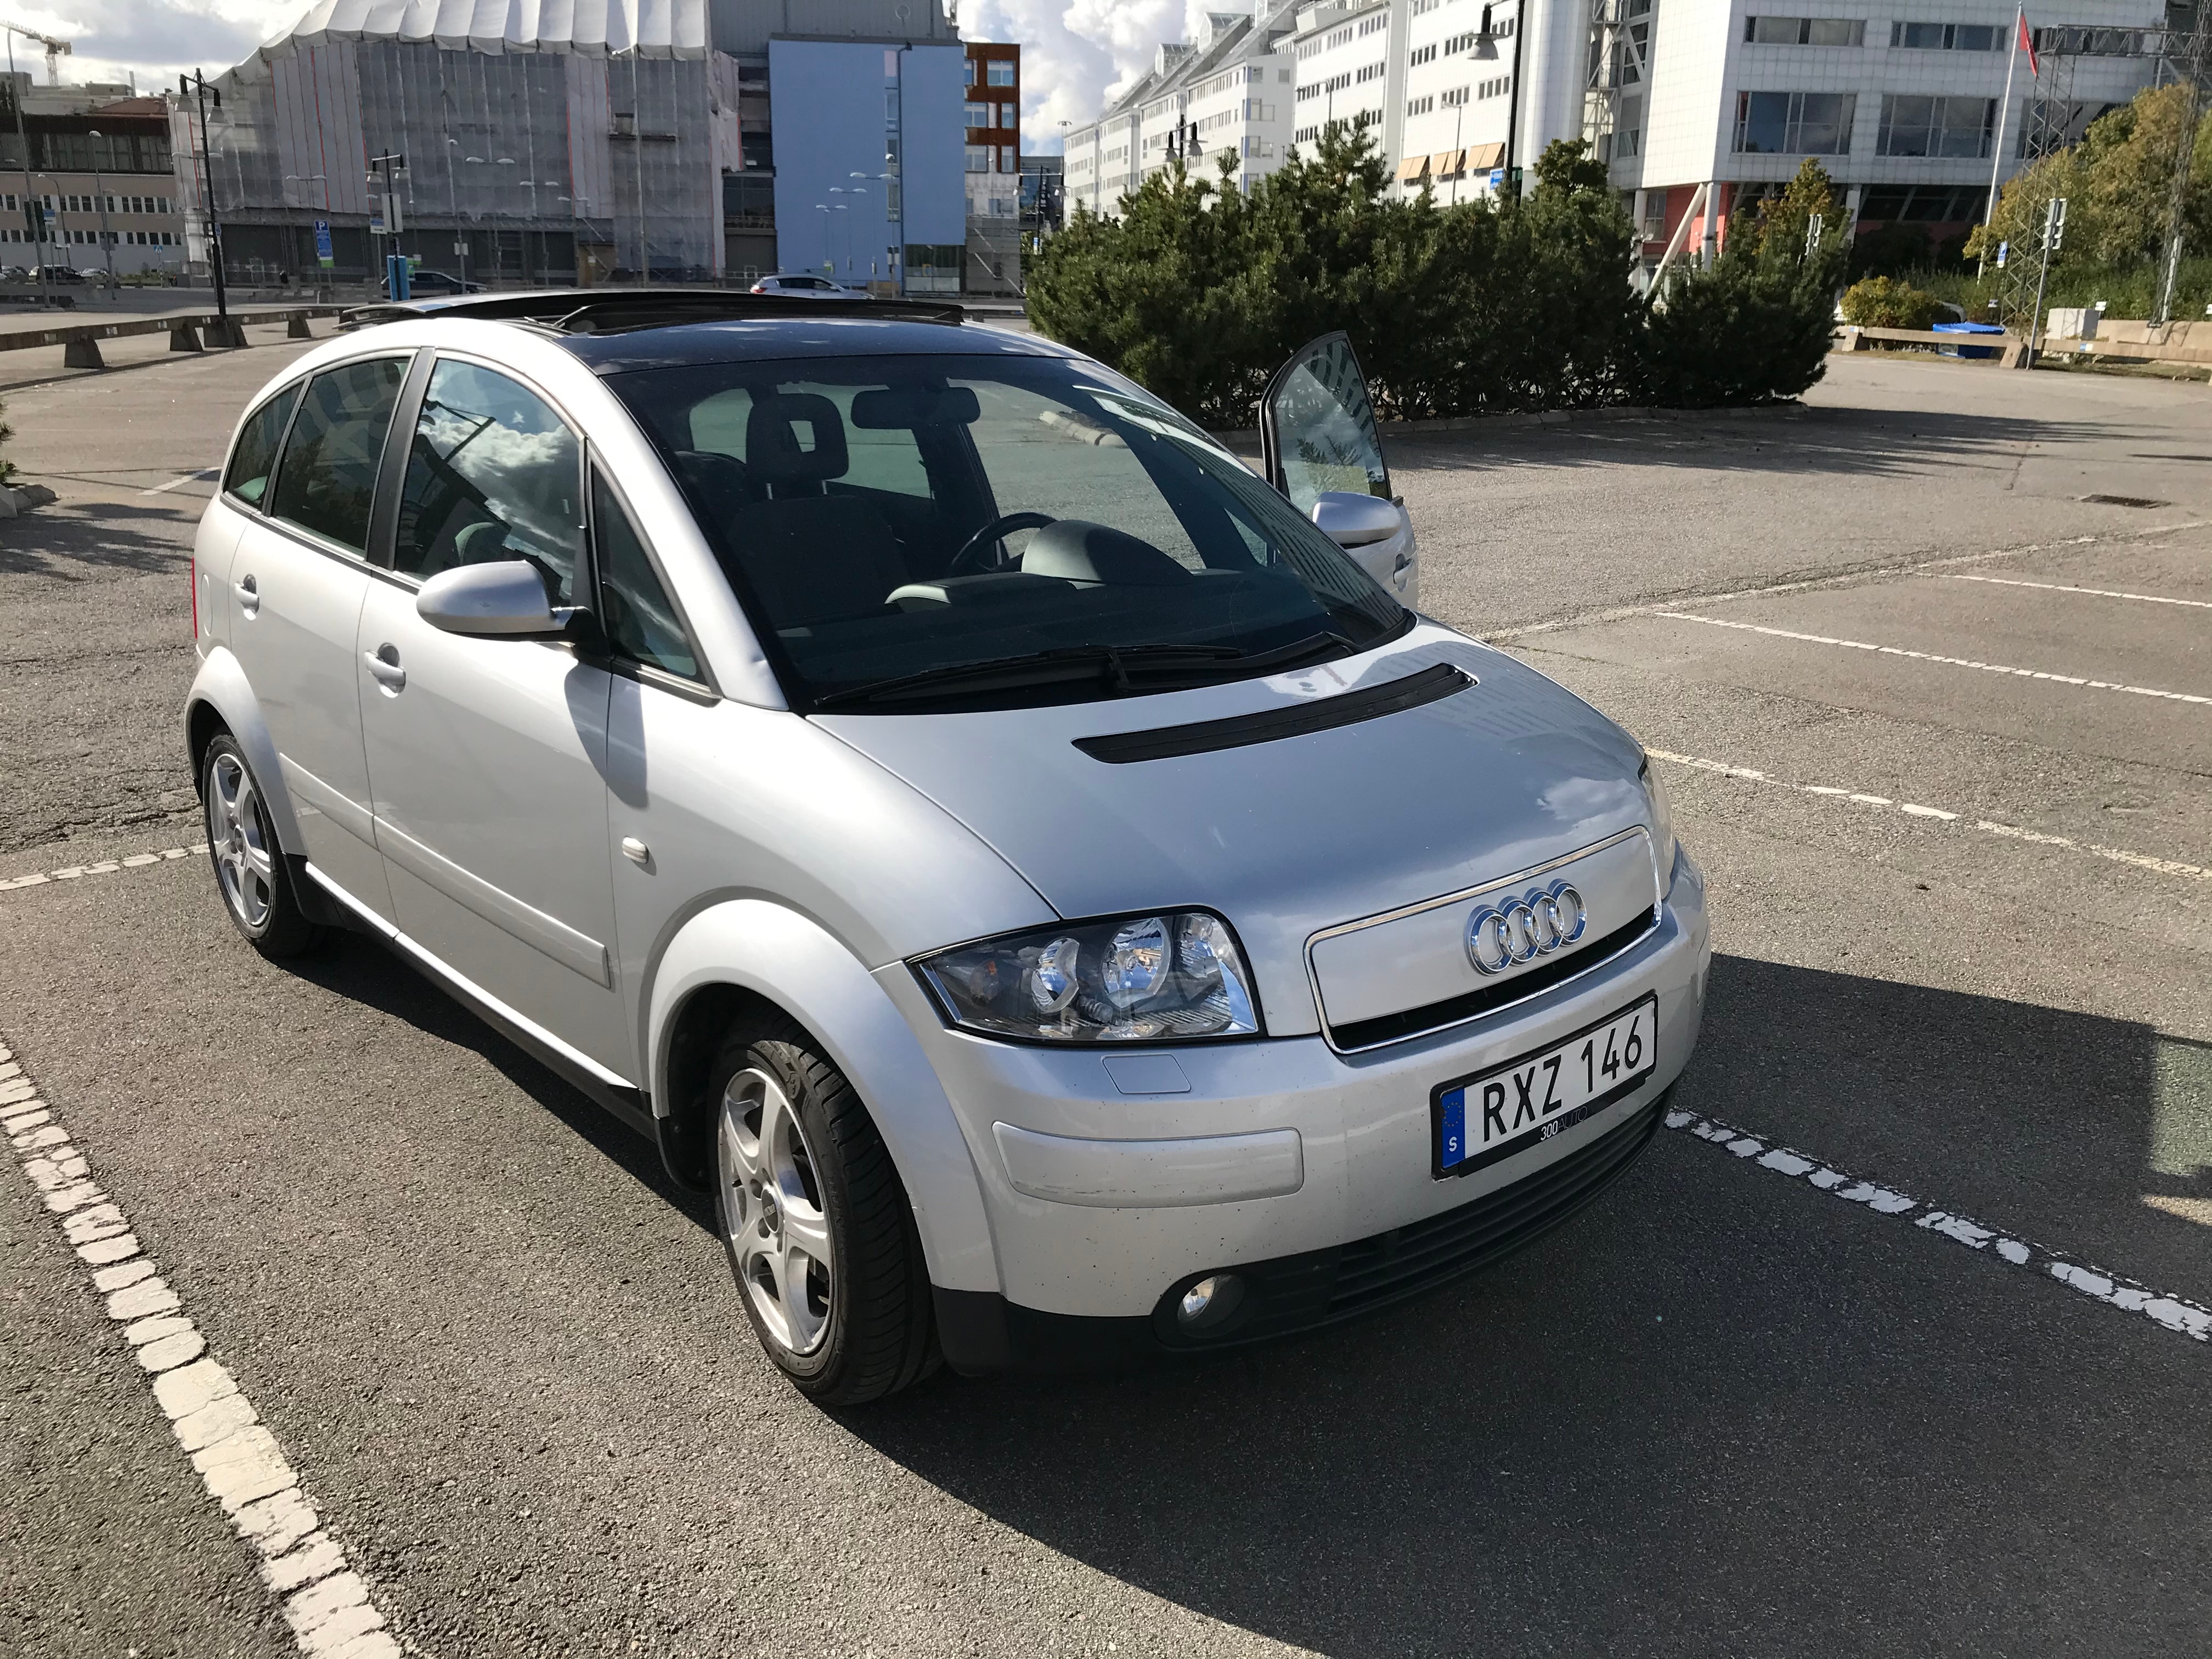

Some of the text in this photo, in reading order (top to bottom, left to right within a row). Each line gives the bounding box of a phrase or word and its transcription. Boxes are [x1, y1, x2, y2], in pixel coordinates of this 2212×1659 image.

[319, 222, 325, 230] P
[1484, 1015, 1641, 1142] RXZ 146
[1449, 1137, 1457, 1152] S
